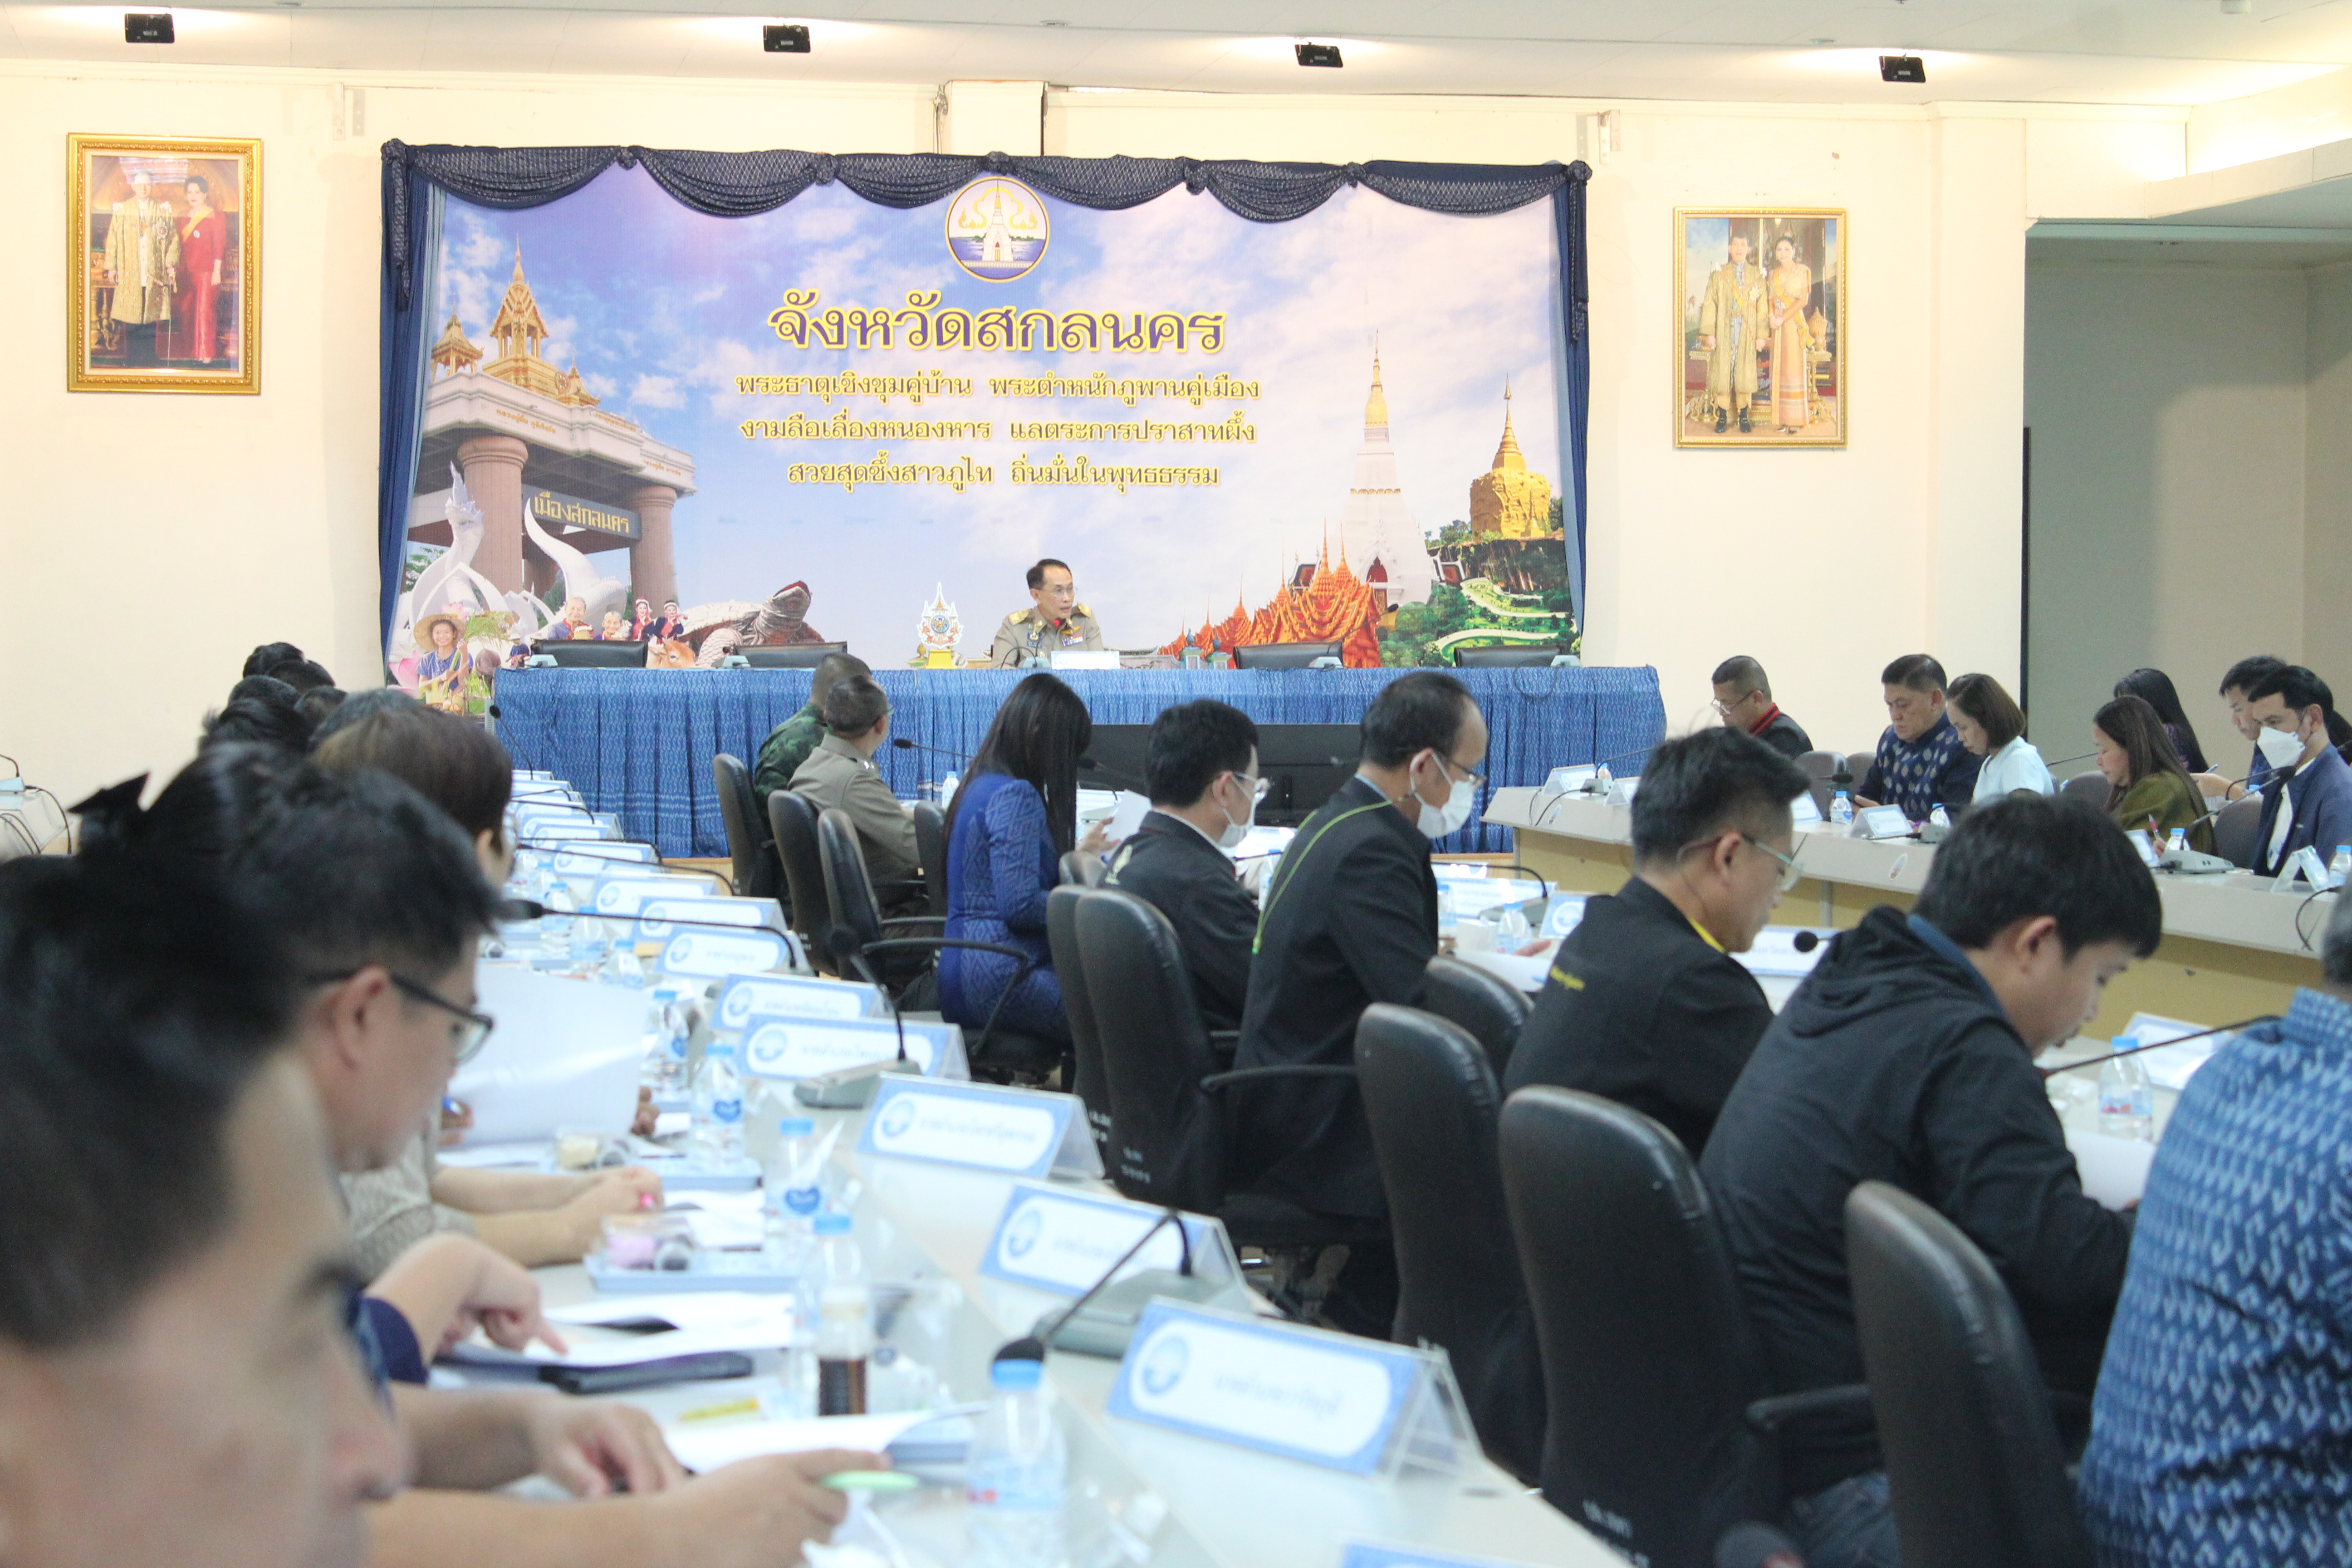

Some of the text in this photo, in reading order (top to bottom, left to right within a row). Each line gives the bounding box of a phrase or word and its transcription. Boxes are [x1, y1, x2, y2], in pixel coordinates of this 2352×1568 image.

[768, 289, 1227, 354] จังหวัดสกลนคร
[735, 369, 1261, 408] พระธาตุเชิงชุมคู่บ้าน พระตำหนักภูพานคู่เมือง
[740, 407, 1257, 443] งามลือเลื่องหนองหาร แลตระการปราสาทผึ้ง
[788, 450, 1220, 495] สวยสุดซึ้งสาวภูไท ถิ่นมั่นในพุทธธรรม
[534, 491, 629, 534] เมืองสกลนคร
